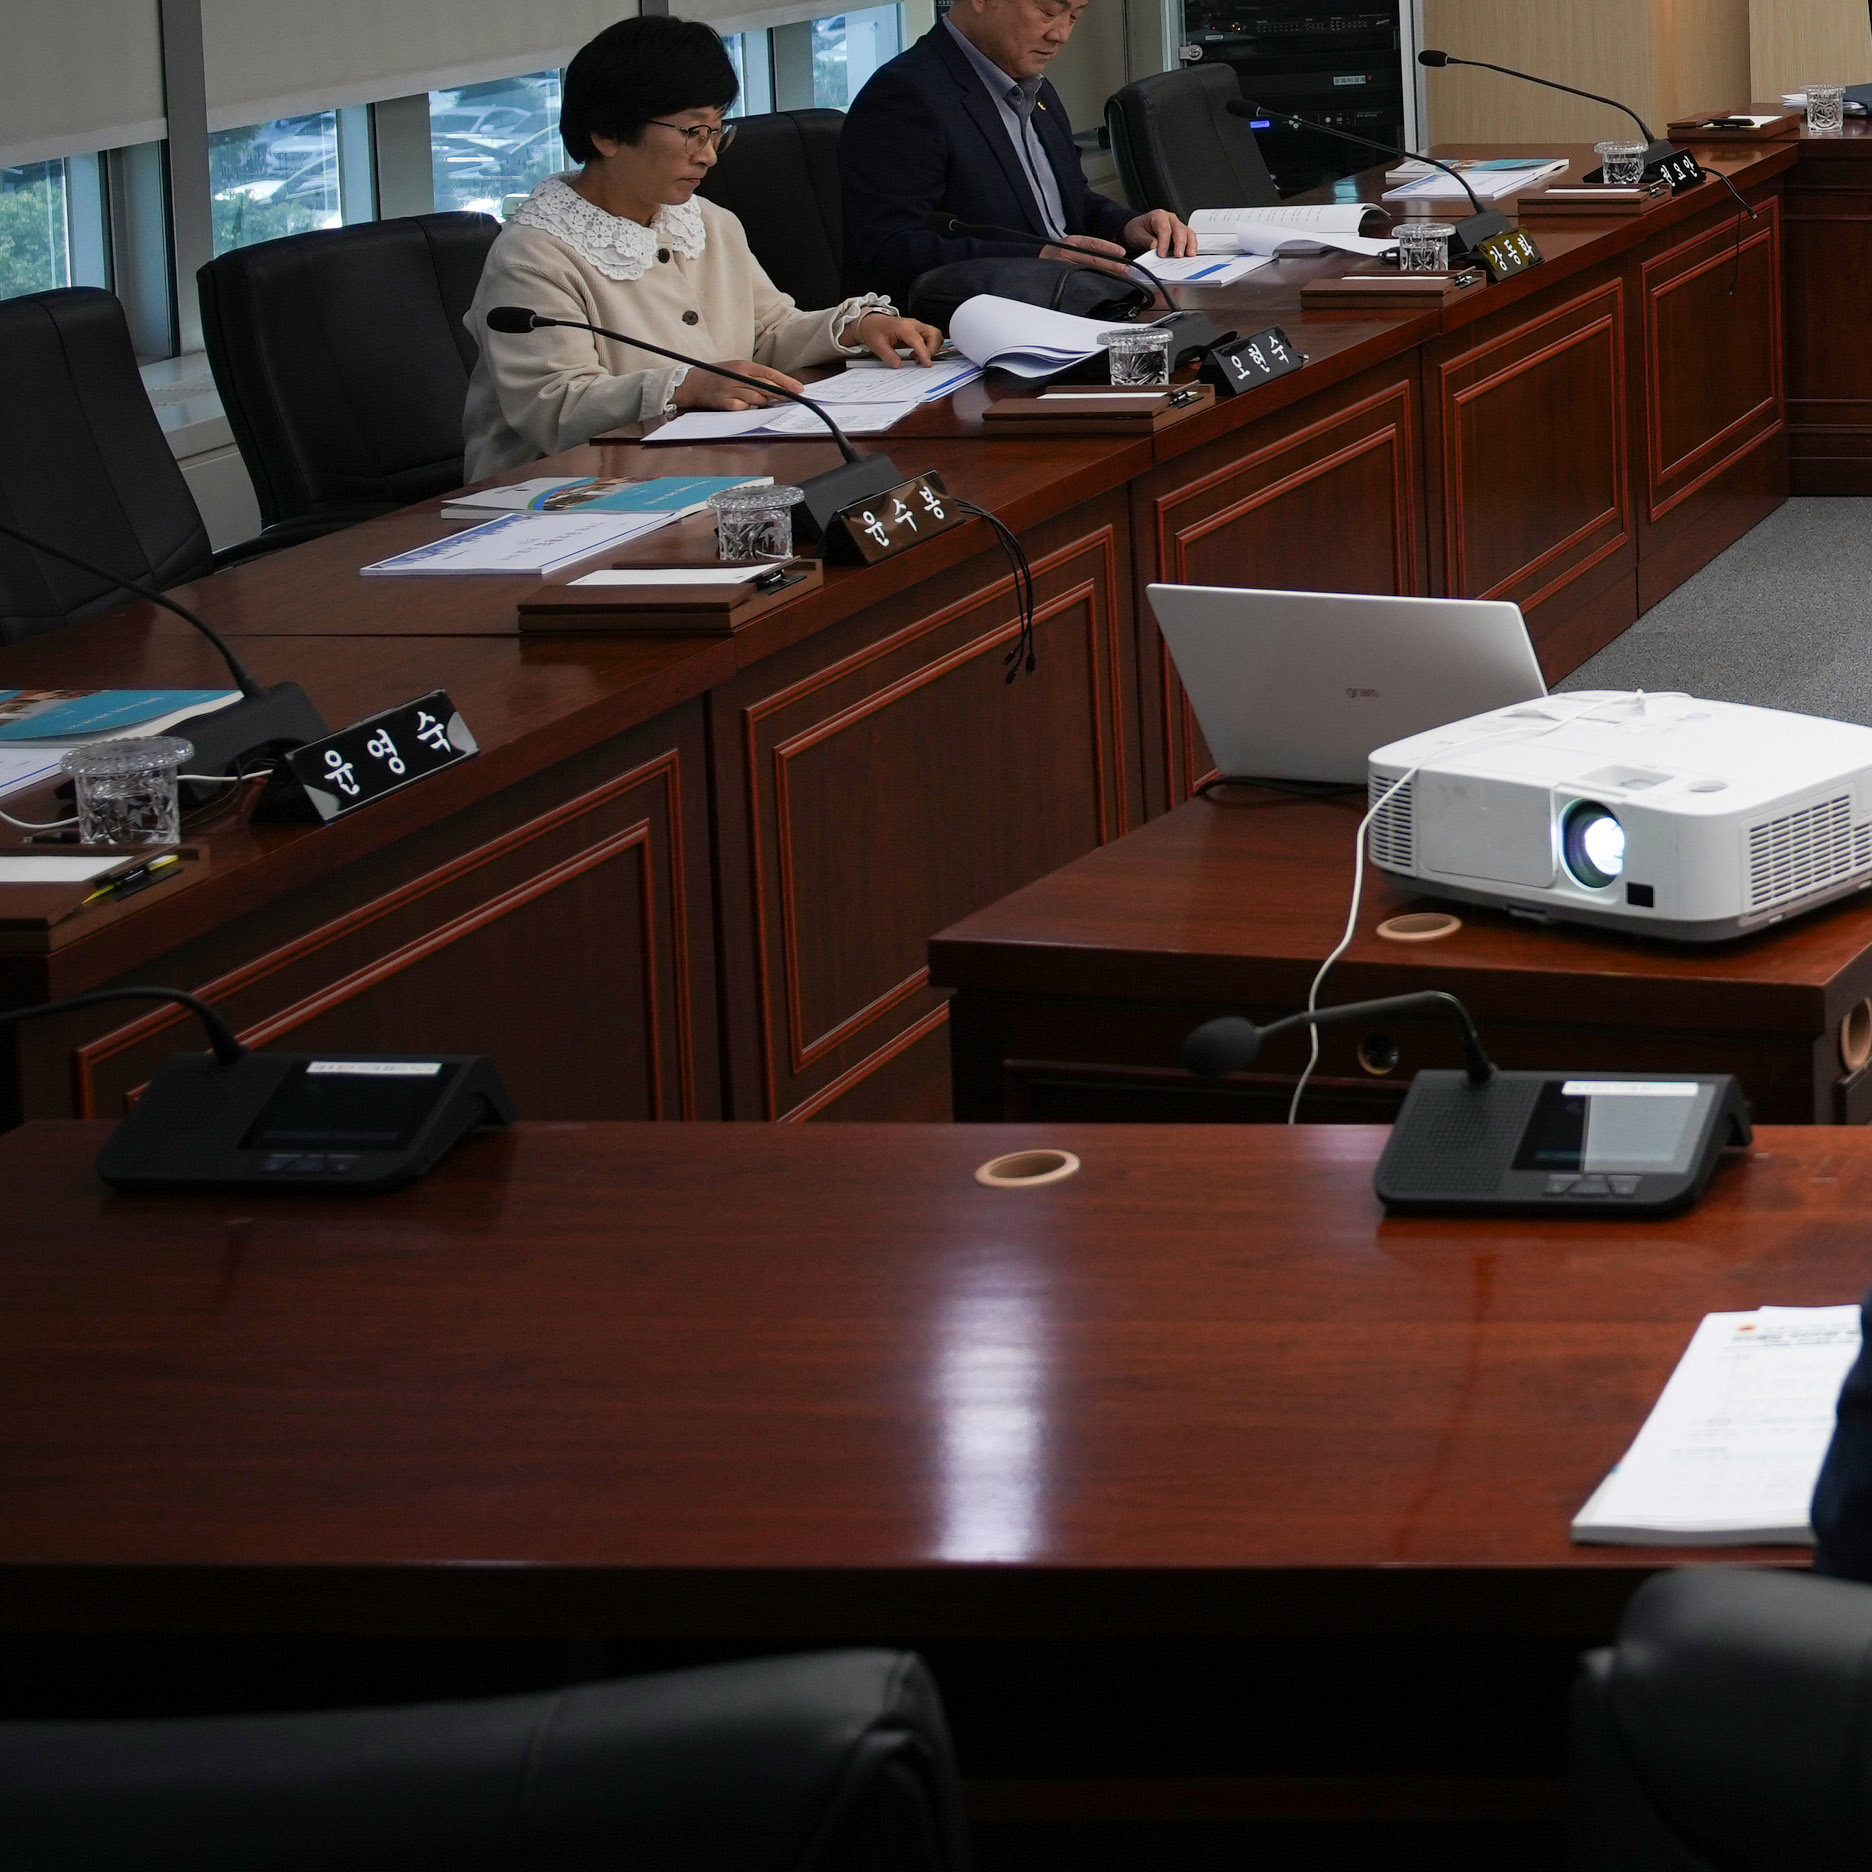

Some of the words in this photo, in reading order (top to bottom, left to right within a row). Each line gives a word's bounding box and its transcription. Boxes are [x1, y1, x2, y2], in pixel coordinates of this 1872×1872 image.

[1489, 235, 1534, 273] 강동화
[861, 484, 946, 548] 윤수봉
[322, 709, 453, 797] 윤영숙
